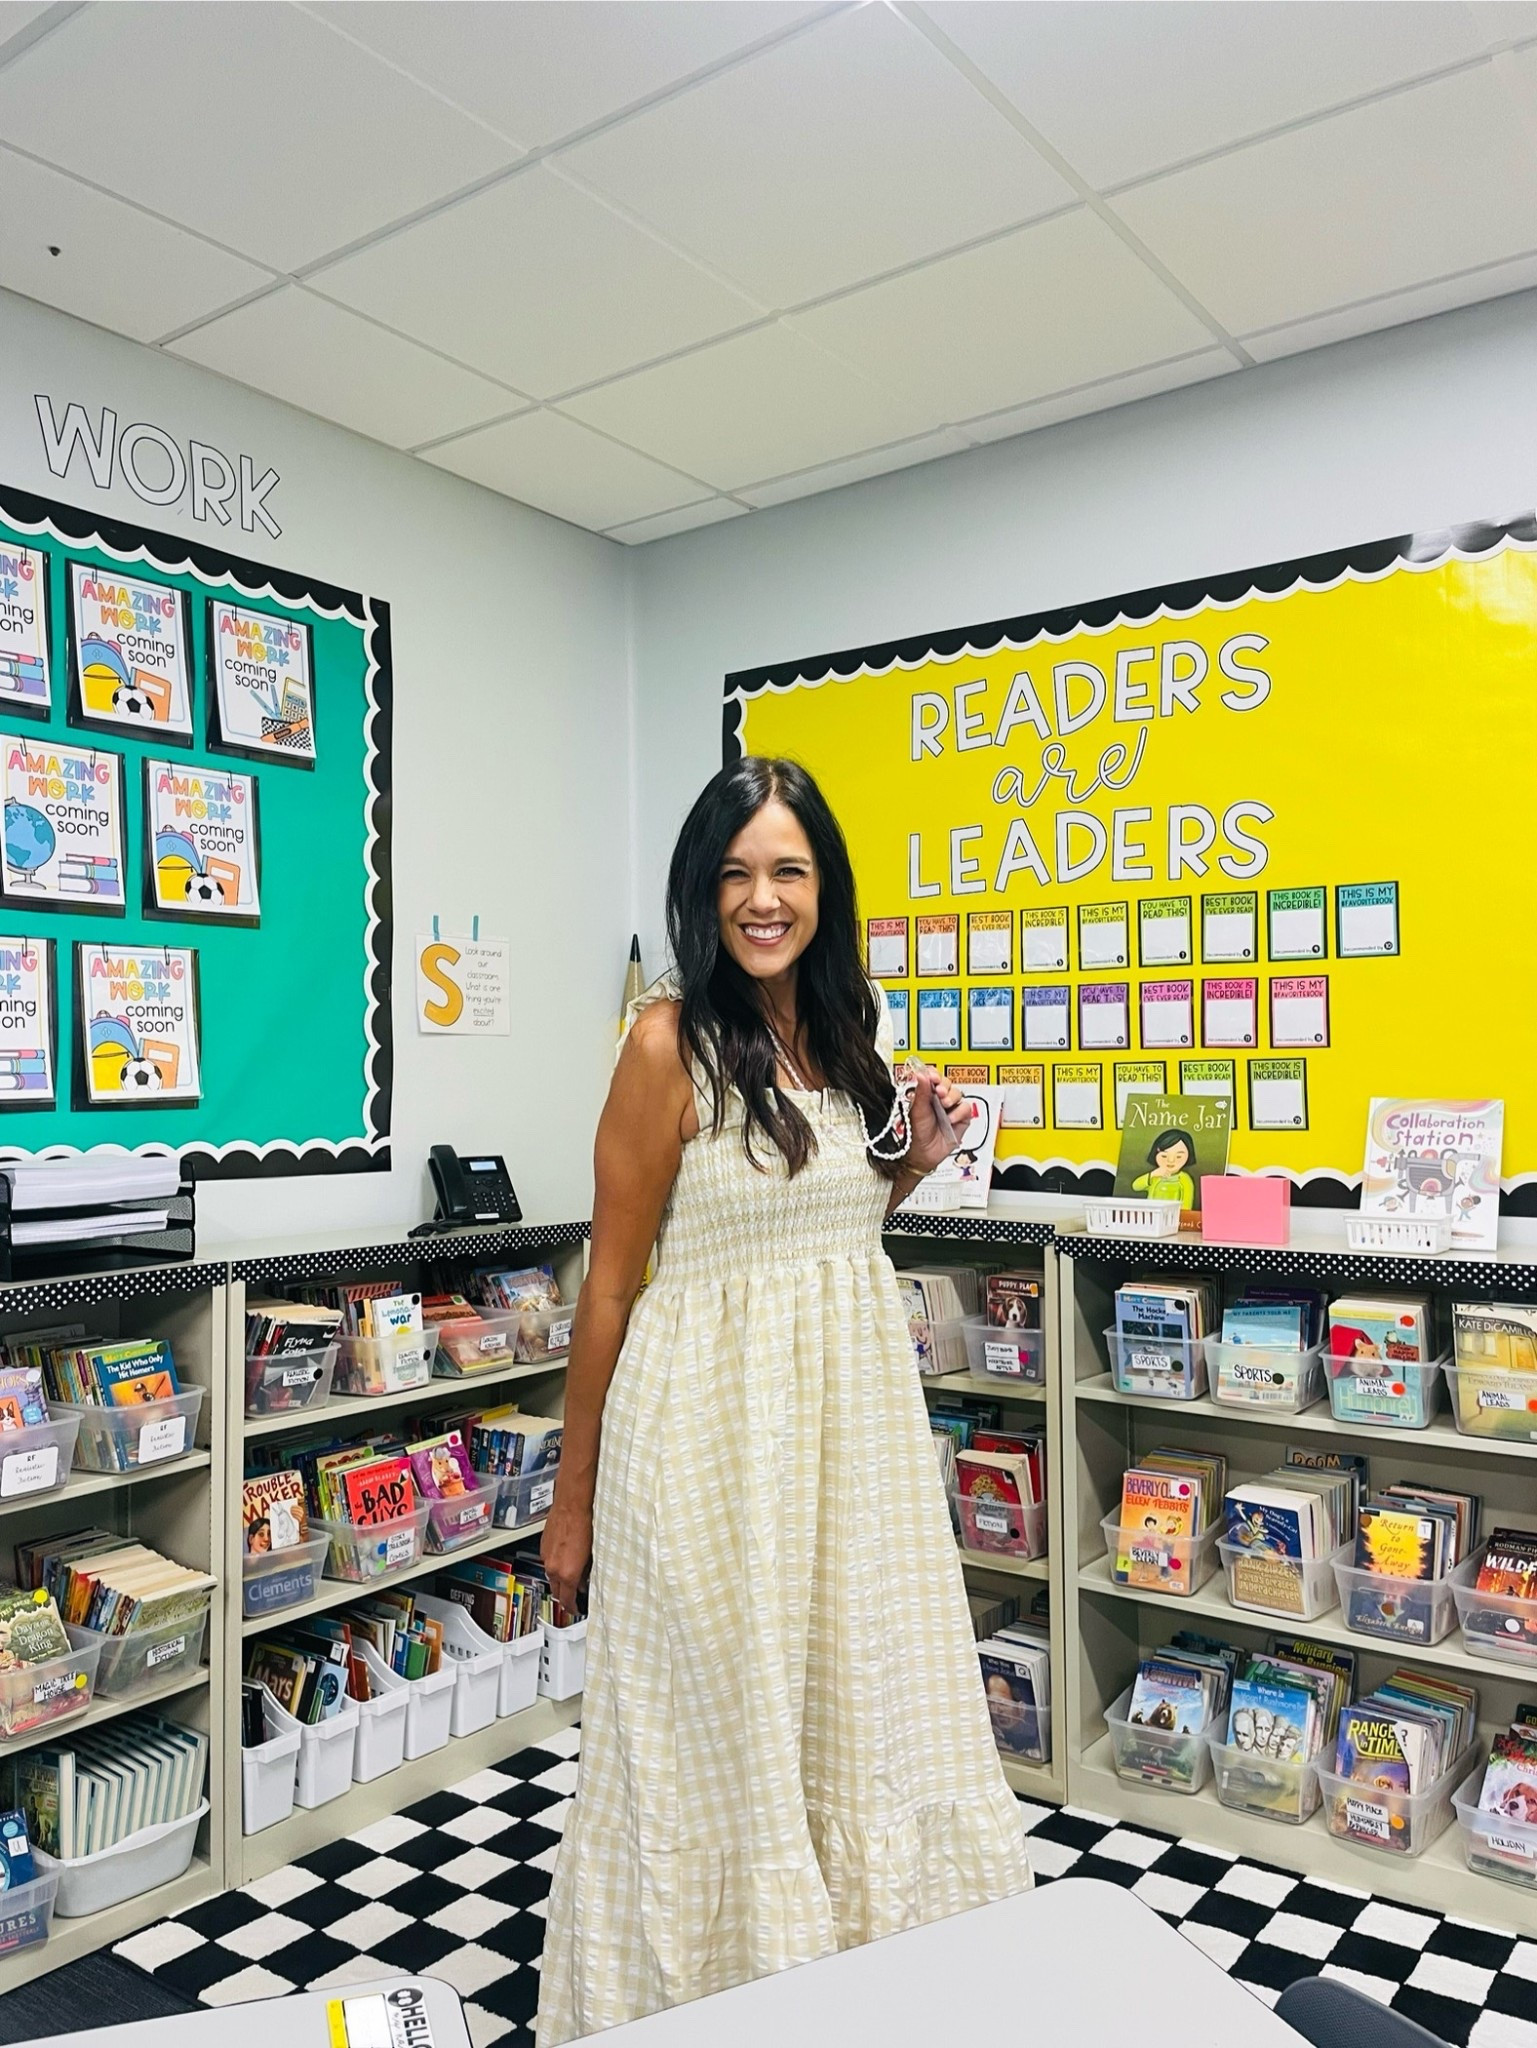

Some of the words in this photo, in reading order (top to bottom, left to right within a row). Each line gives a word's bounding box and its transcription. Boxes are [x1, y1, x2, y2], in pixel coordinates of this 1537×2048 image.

[35, 395, 282, 540] WORK
[81, 578, 175, 619] AMAZING
[100, 604, 162, 635] WORK
[220, 614, 300, 652] AMAZING
[116, 631, 175, 658] coming
[237, 638, 290, 667] WORK
[128, 649, 167, 670] soon
[225, 658, 276, 684] coming
[235, 673, 269, 692] soon
[910, 633, 1272, 761] READERS
[8, 749, 110, 785] AMAZING
[992, 726, 1148, 808] are
[29, 776, 95, 801] WORK
[158, 774, 245, 805] AMAZING
[45, 803, 110, 826] coming
[175, 798, 231, 821] WORK
[57, 818, 100, 837] soon
[190, 821, 244, 843] coming
[200, 837, 236, 853] soon
[909, 801, 1275, 899] LEADERS
[1205, 898, 1226, 906] BEST
[1231, 896, 1252, 905] BOOK
[1292, 891, 1310, 899] BOOK
[1314, 890, 1320, 898] IS
[1341, 889, 1361, 899] THIS
[1365, 888, 1375, 897] IS
[1378, 886, 1393, 896] MY
[1082, 908, 1099, 917] THIS
[1102, 907, 1109, 916] IS
[1112, 906, 1124, 914] MY
[1143, 909, 1163, 919] READ
[1167, 908, 1187, 917] THIS!
[1273, 899, 1321, 910] INCREDIBLE!
[90, 957, 184, 981] AMAZING
[110, 981, 171, 1001] WORK
[420, 943, 464, 1027] S
[1144, 984, 1163, 994] BEST
[1166, 984, 1189, 993] BOOK
[1246, 981, 1252, 989] IS
[1274, 981, 1294, 991] THIS
[1297, 981, 1305, 990] IS
[1309, 980, 1324, 989] MY
[1207, 989, 1253, 1000] INCREDIBLE!
[125, 1003, 184, 1022] coming
[136, 1018, 175, 1033] soon
[967, 1068, 985, 1076] BOOK
[1057, 1068, 1073, 1076] THIS
[1076, 1068, 1083, 1076] IS
[1184, 1063, 1204, 1073] BEST
[1208, 1063, 1230, 1072] BOOK
[1254, 1070, 1300, 1080] INCREDIBLE!
[1272, 1062, 1290, 1070] BOOK
[1002, 1076, 1040, 1084] INCREDIBLE!
[1155, 1099, 1170, 1108] The
[1129, 1102, 1189, 1128] Name
[1193, 1105, 1227, 1131] Jar
[1386, 1113, 1485, 1130] Collaboration
[1393, 1130, 1474, 1146] Station
[1138, 1313, 1165, 1321] Machine
[1458, 1319, 1482, 1331] KATE
[120, 1363, 131, 1372] Kid
[132, 1359, 148, 1369] Who
[149, 1354, 163, 1364] Only
[130, 1365, 154, 1375] Homers
[1134, 1356, 1168, 1368] SPORTS
[1234, 1365, 1272, 1383] SPORTS
[1126, 1477, 1161, 1497] BEVERLY
[361, 1482, 404, 1514] BAD
[1126, 1494, 1150, 1506] ELLEN
[1153, 1499, 1189, 1513] TEBBITS
[1380, 1518, 1414, 1535] Return
[1390, 1535, 1401, 1543] to
[249, 1574, 312, 1601] Clements
[19, 1627, 53, 1645] Dragon
[29, 1640, 53, 1653] King
[1293, 1640, 1334, 1663] Military
[254, 1666, 293, 1700] Mars
[1257, 1686, 1277, 1697] Where
[1492, 1837, 1525, 1853] HOLIDAY
